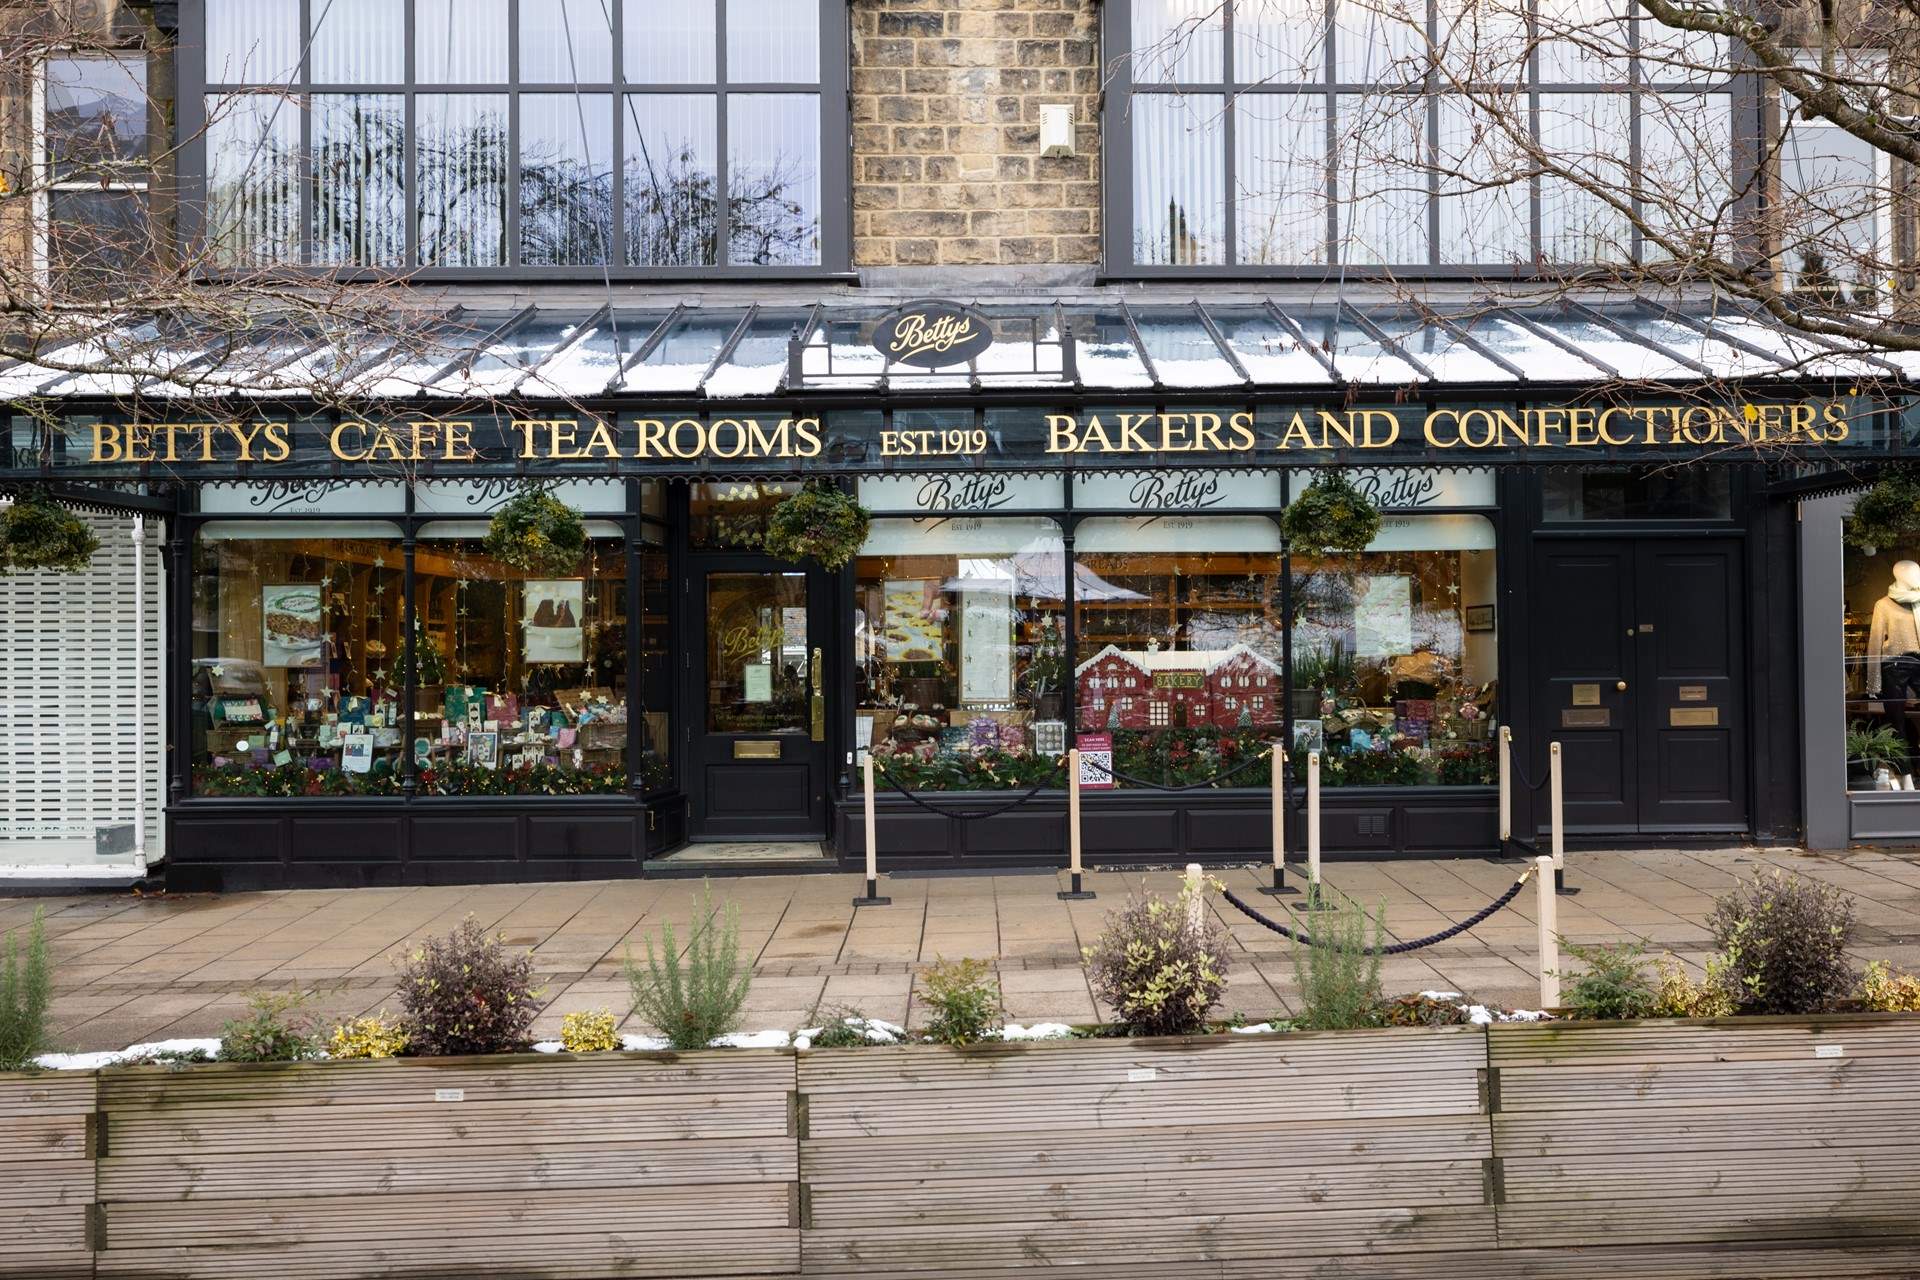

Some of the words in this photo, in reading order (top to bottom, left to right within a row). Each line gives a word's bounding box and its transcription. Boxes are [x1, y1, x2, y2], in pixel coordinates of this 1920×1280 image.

[890, 314, 979, 361] Bettys
[89, 423, 290, 462] BETTYS
[330, 421, 475, 461] CAFE
[511, 420, 622, 458] TEA
[634, 418, 822, 458] ROOMS
[1044, 412, 1255, 453] BAKERS
[1277, 410, 1400, 450] AND
[1423, 403, 1849, 448] CONFECTIONERS
[913, 478, 1016, 522] Bettys
[1129, 476, 1227, 517] Bettys
[1351, 473, 1443, 507] Bettys
[1156, 675, 1201, 686] BAKERY
